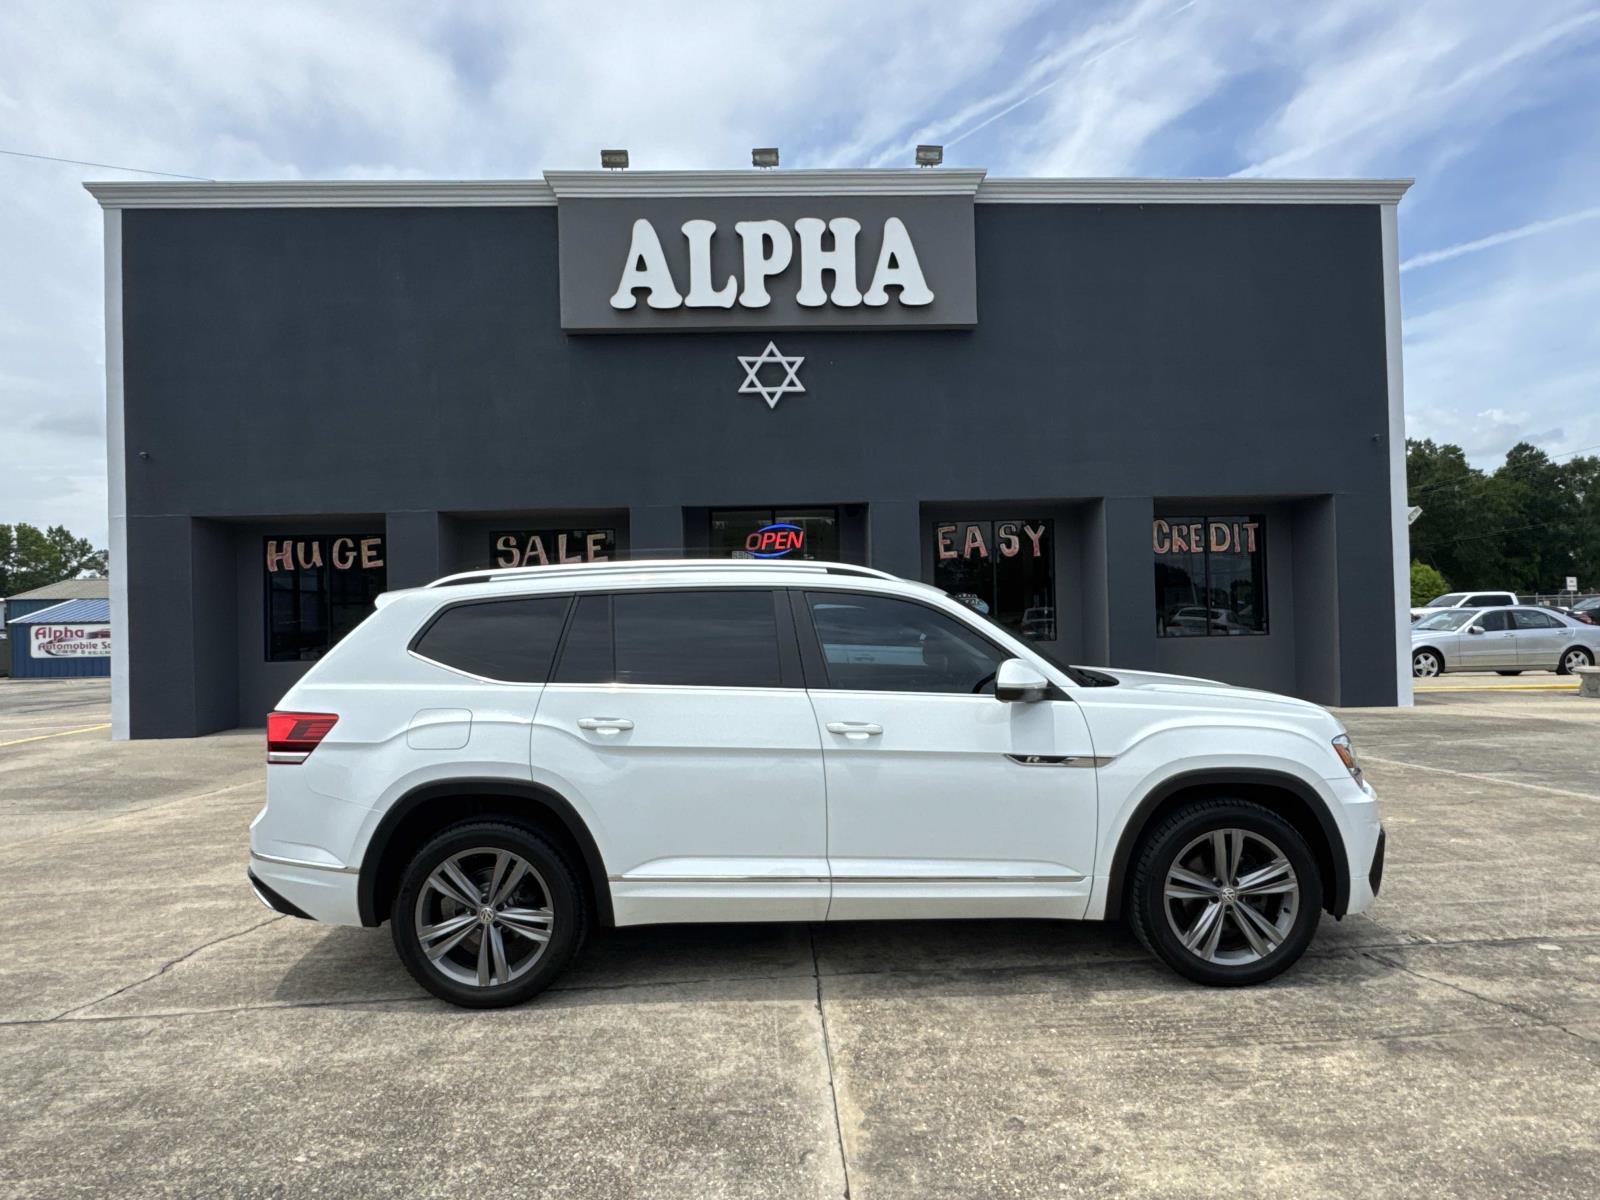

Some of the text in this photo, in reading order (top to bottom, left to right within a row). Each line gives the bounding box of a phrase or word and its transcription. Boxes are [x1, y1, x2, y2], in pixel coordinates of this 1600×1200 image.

[609, 216, 935, 309] ALPHA
[265, 532, 610, 573] HUGE SALE
[745, 531, 804, 551] OPEN
[936, 518, 1259, 560] EASY CREDIT
[35, 626, 85, 641] Alpha
[38, 642, 98, 651] Automobile
